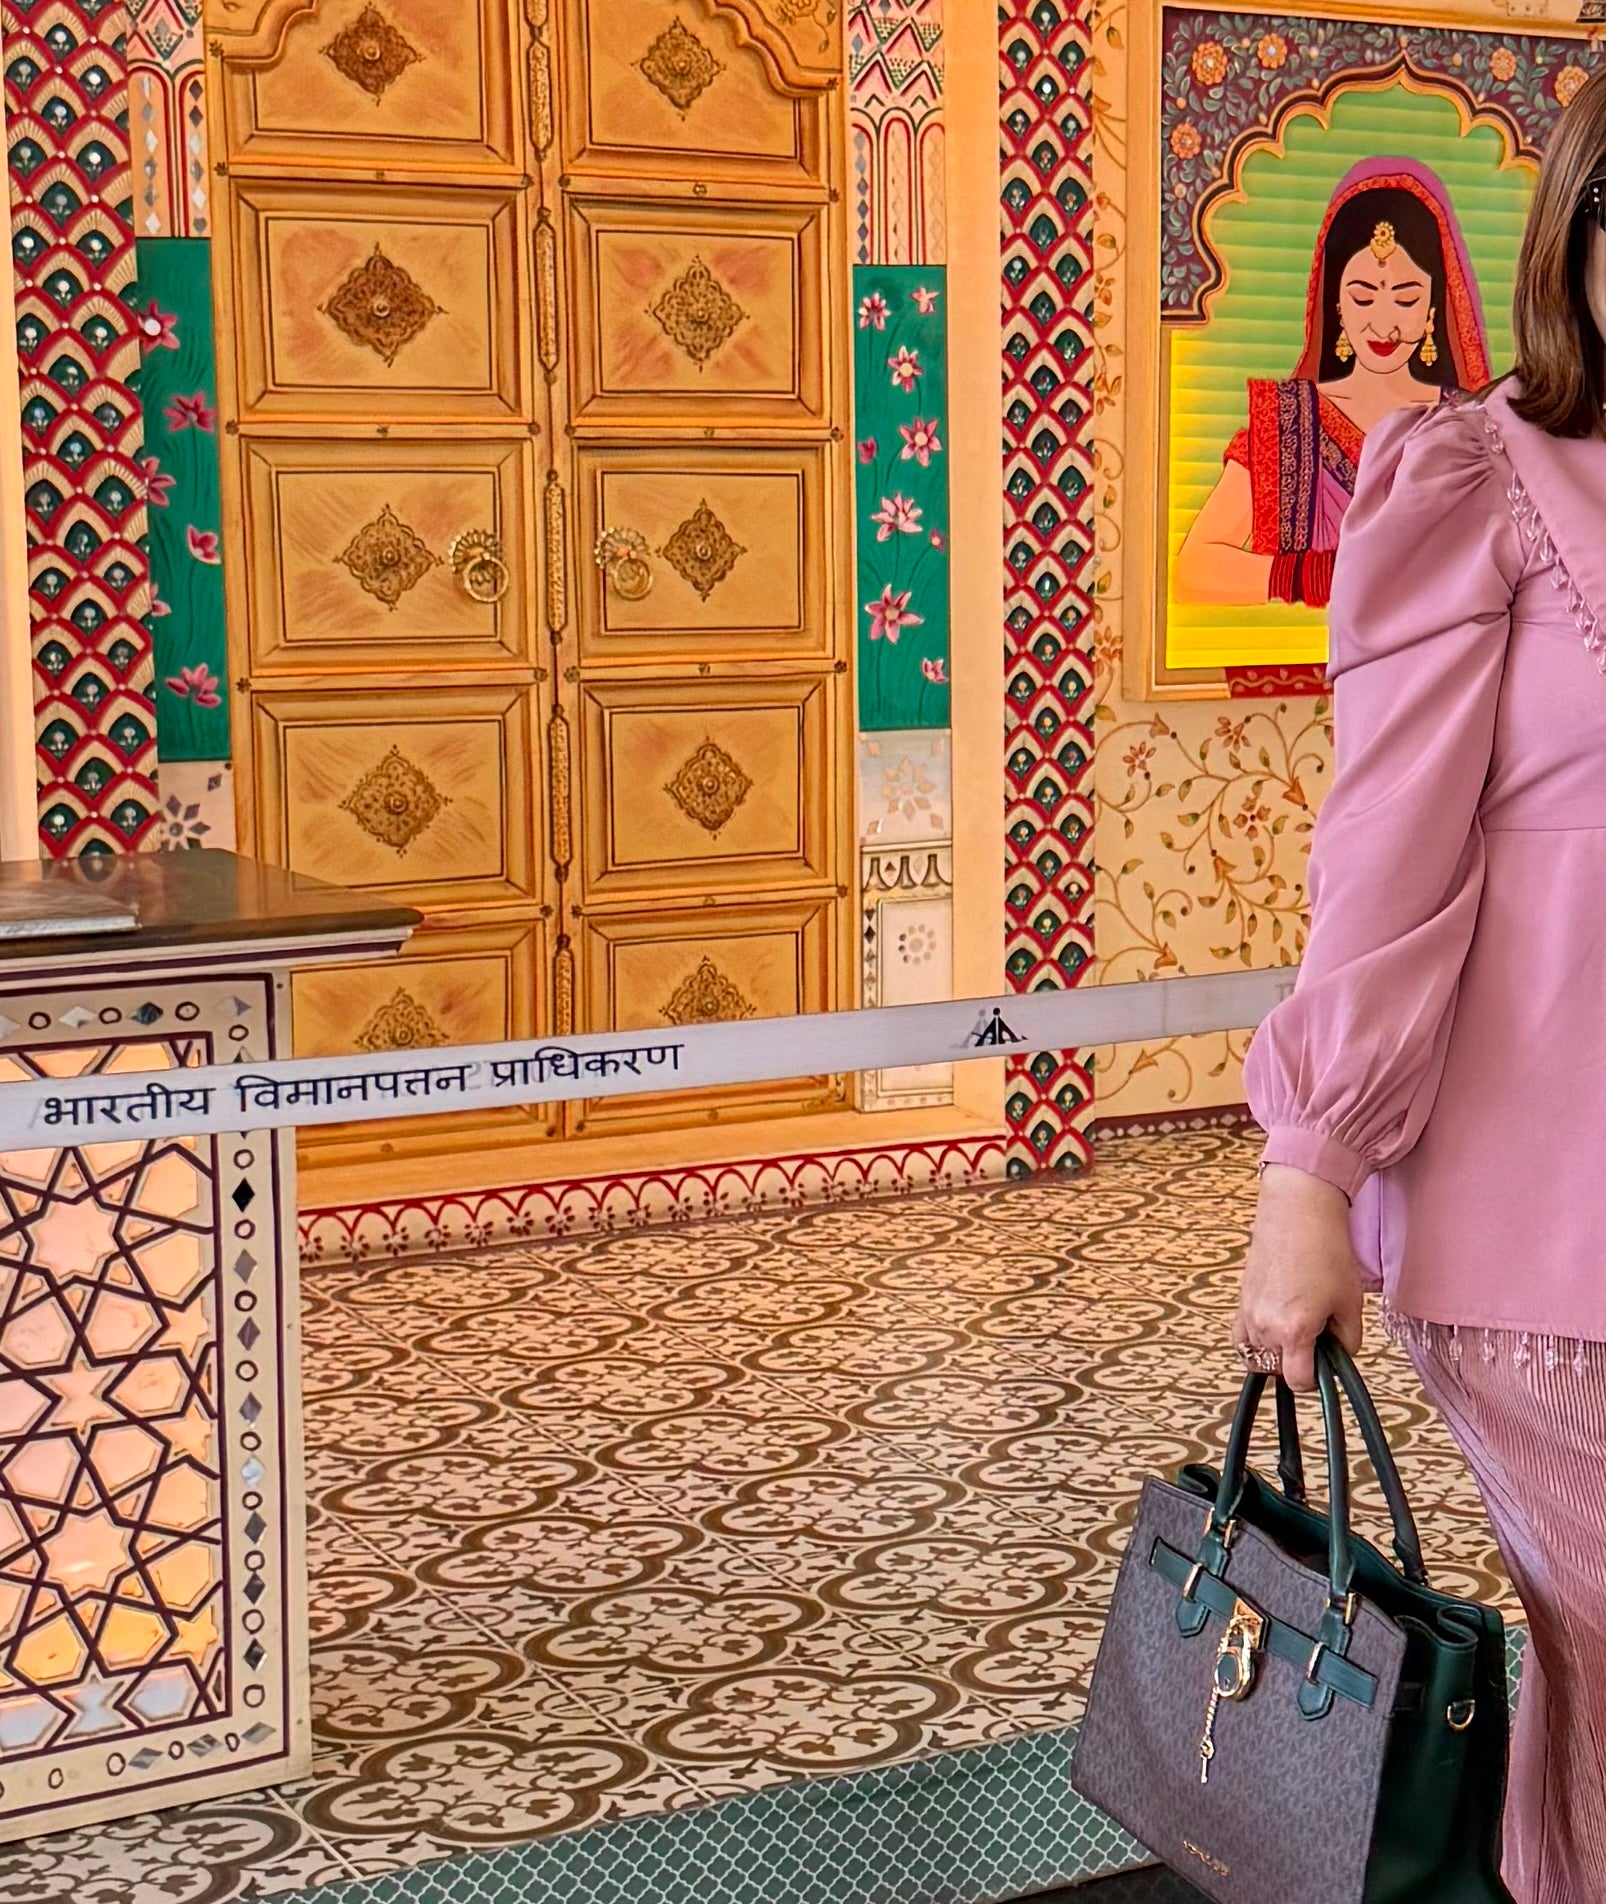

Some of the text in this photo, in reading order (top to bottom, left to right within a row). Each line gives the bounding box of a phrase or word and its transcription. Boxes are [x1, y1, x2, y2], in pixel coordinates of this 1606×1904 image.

[44, 1044, 685, 1126] भारतीय विमानपत्तन प्राधिकरण
